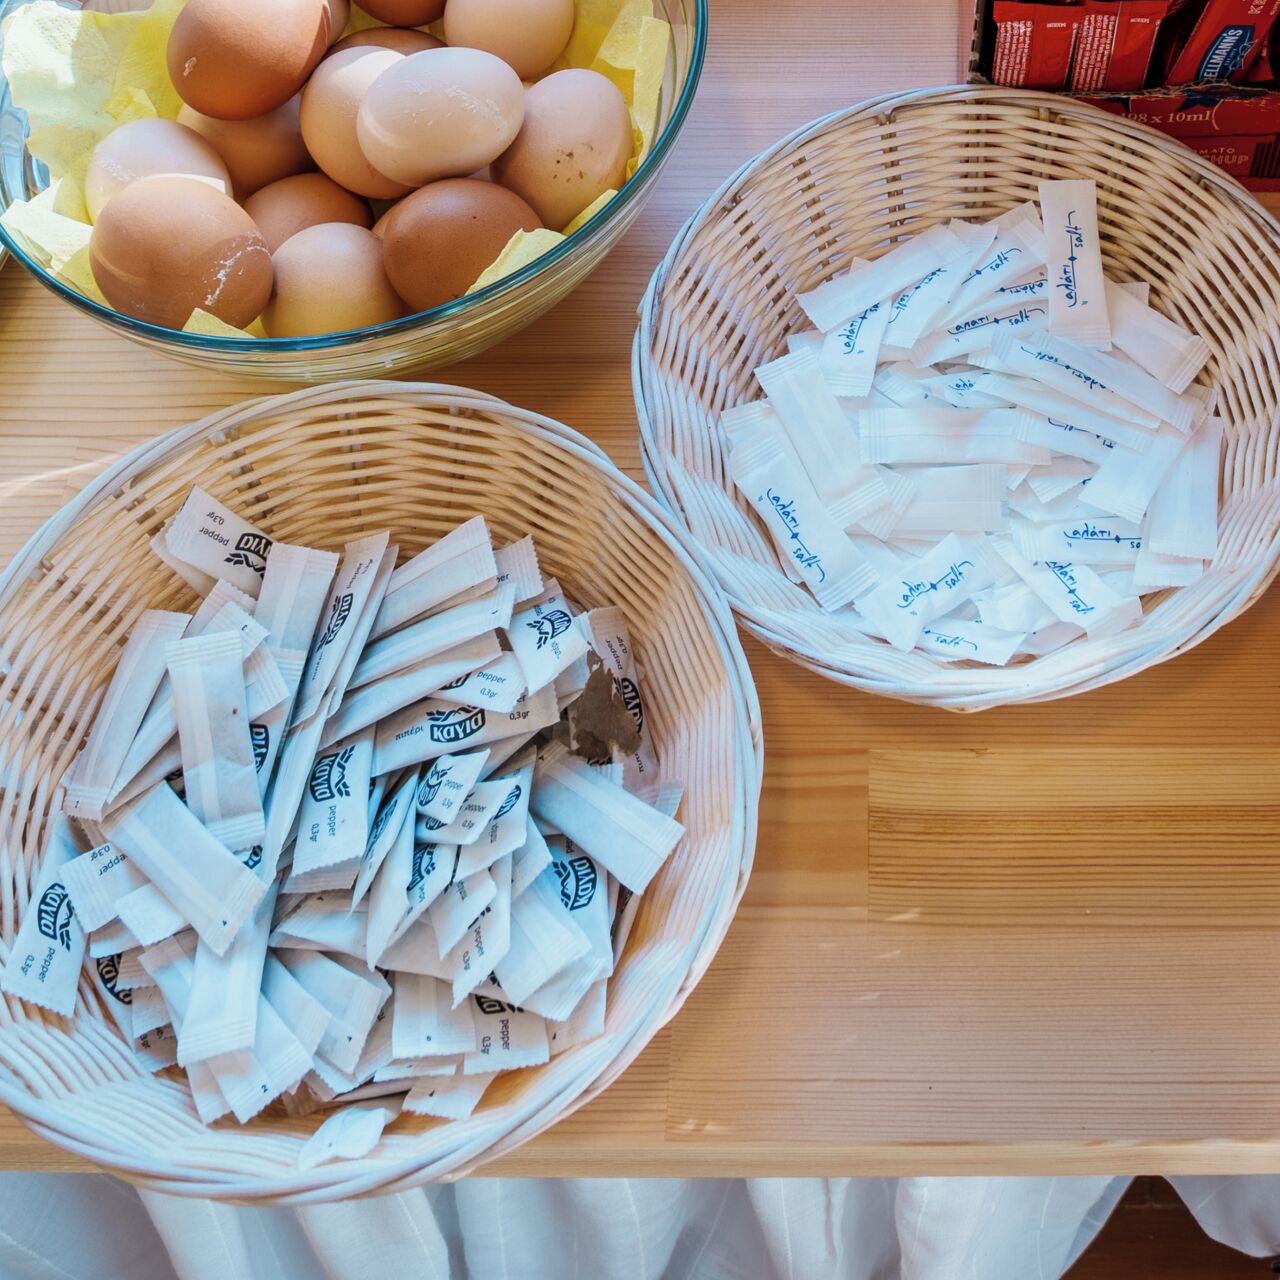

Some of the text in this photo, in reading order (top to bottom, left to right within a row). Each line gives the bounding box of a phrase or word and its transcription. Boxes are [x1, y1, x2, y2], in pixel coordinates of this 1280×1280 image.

[1204, 28, 1244, 79] ELLMANN'S
[1168, 110, 1211, 122] 10ml
[1065, 225, 1084, 248] salt
[990, 251, 1010, 272] salt
[1008, 308, 1030, 326] salt
[198, 526, 230, 546] pepper
[1072, 522, 1111, 538] αλάτι
[793, 547, 821, 568] salt
[945, 563, 964, 590] salt
[935, 635, 964, 647] salt
[477, 671, 507, 684] pepper
[328, 805, 337, 837] pepper
[99, 853, 128, 876] epper
[39, 947, 56, 982] pepper
[500, 1019, 512, 1051] pepper
